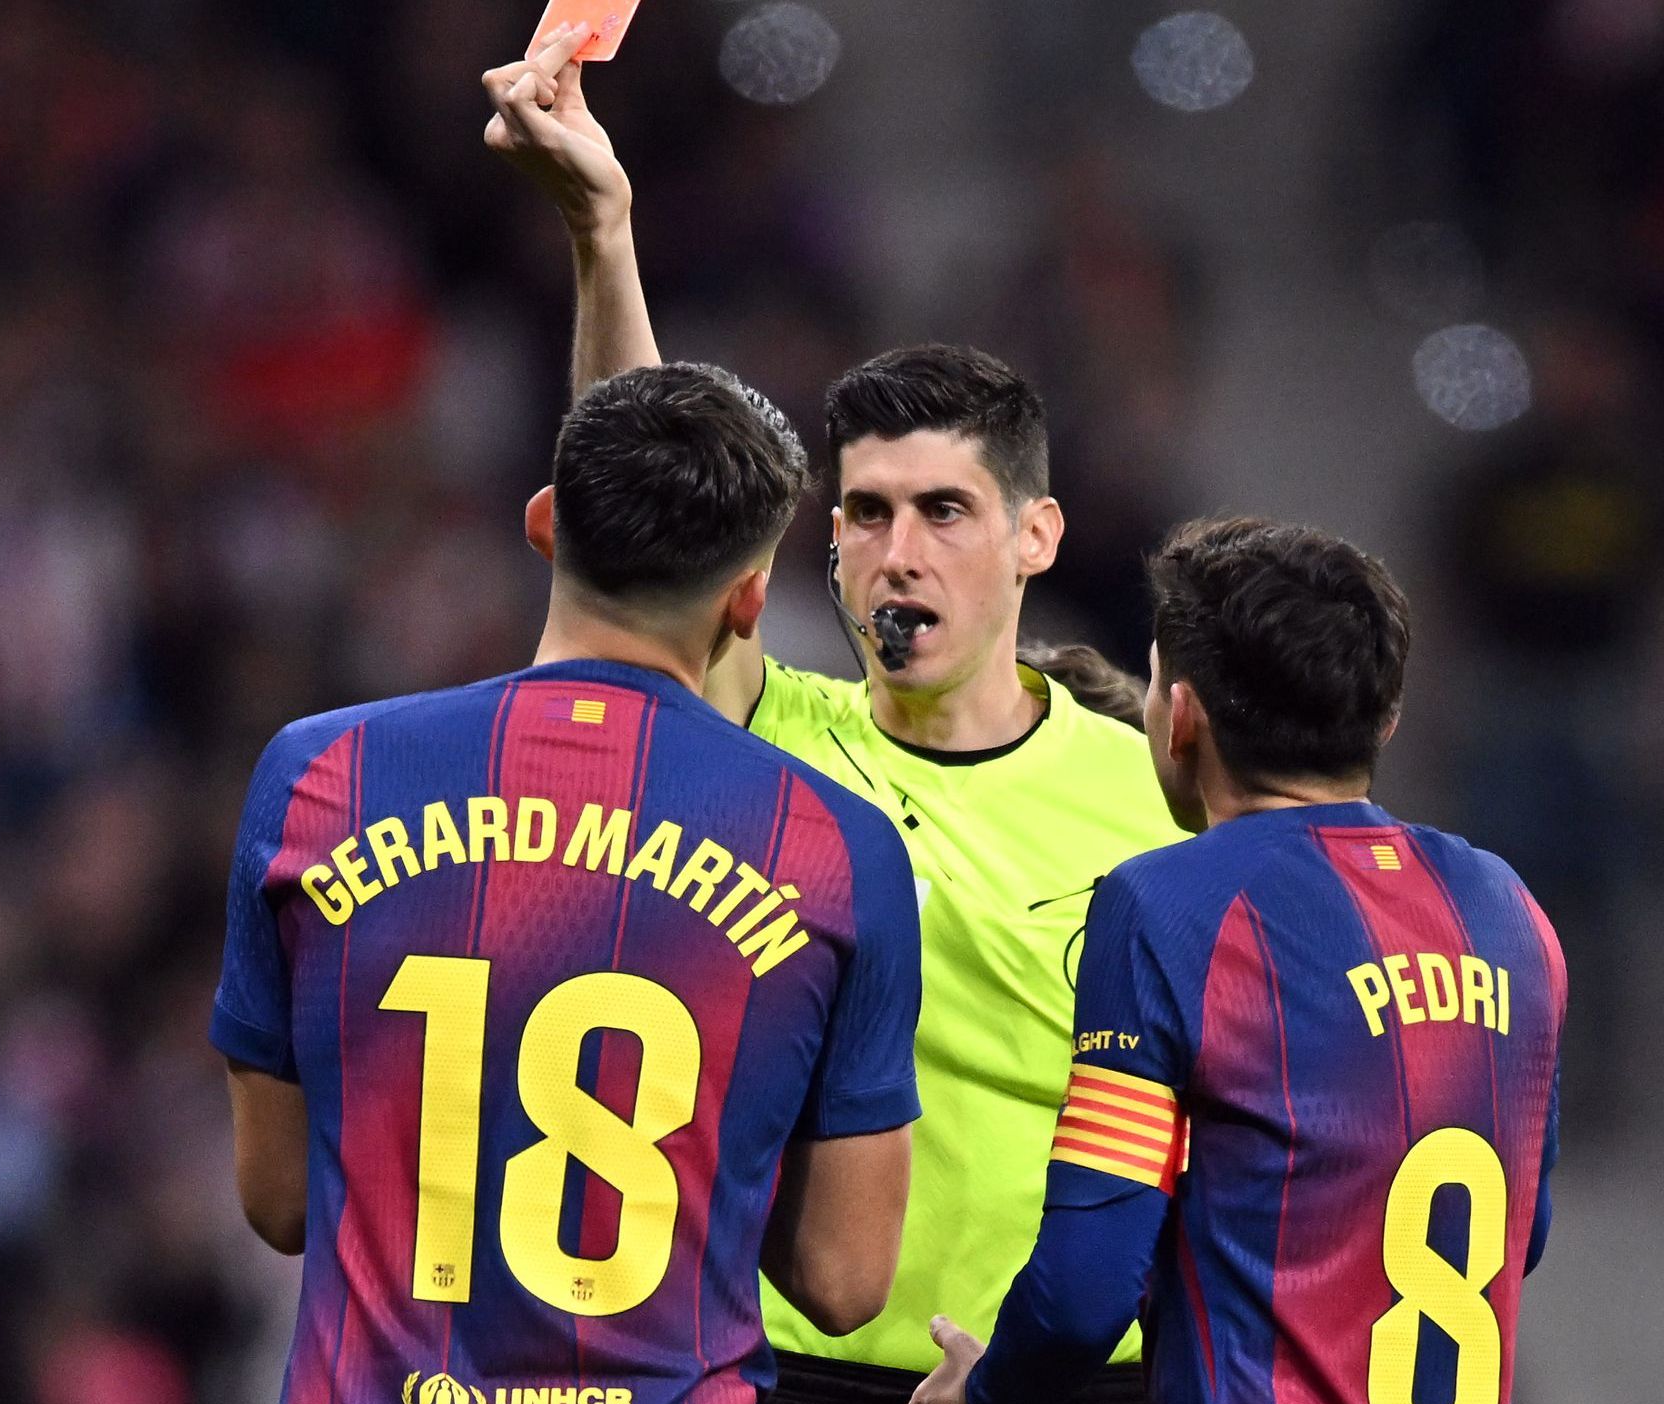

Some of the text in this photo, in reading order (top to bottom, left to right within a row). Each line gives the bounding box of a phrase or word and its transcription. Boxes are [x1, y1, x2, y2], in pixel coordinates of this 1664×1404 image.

[300, 795, 810, 979] GERARD MARTÍN
[1117, 1032, 1139, 1050] tv
[1345, 952, 1510, 1036] PEDRI
[377, 954, 701, 1317] 18
